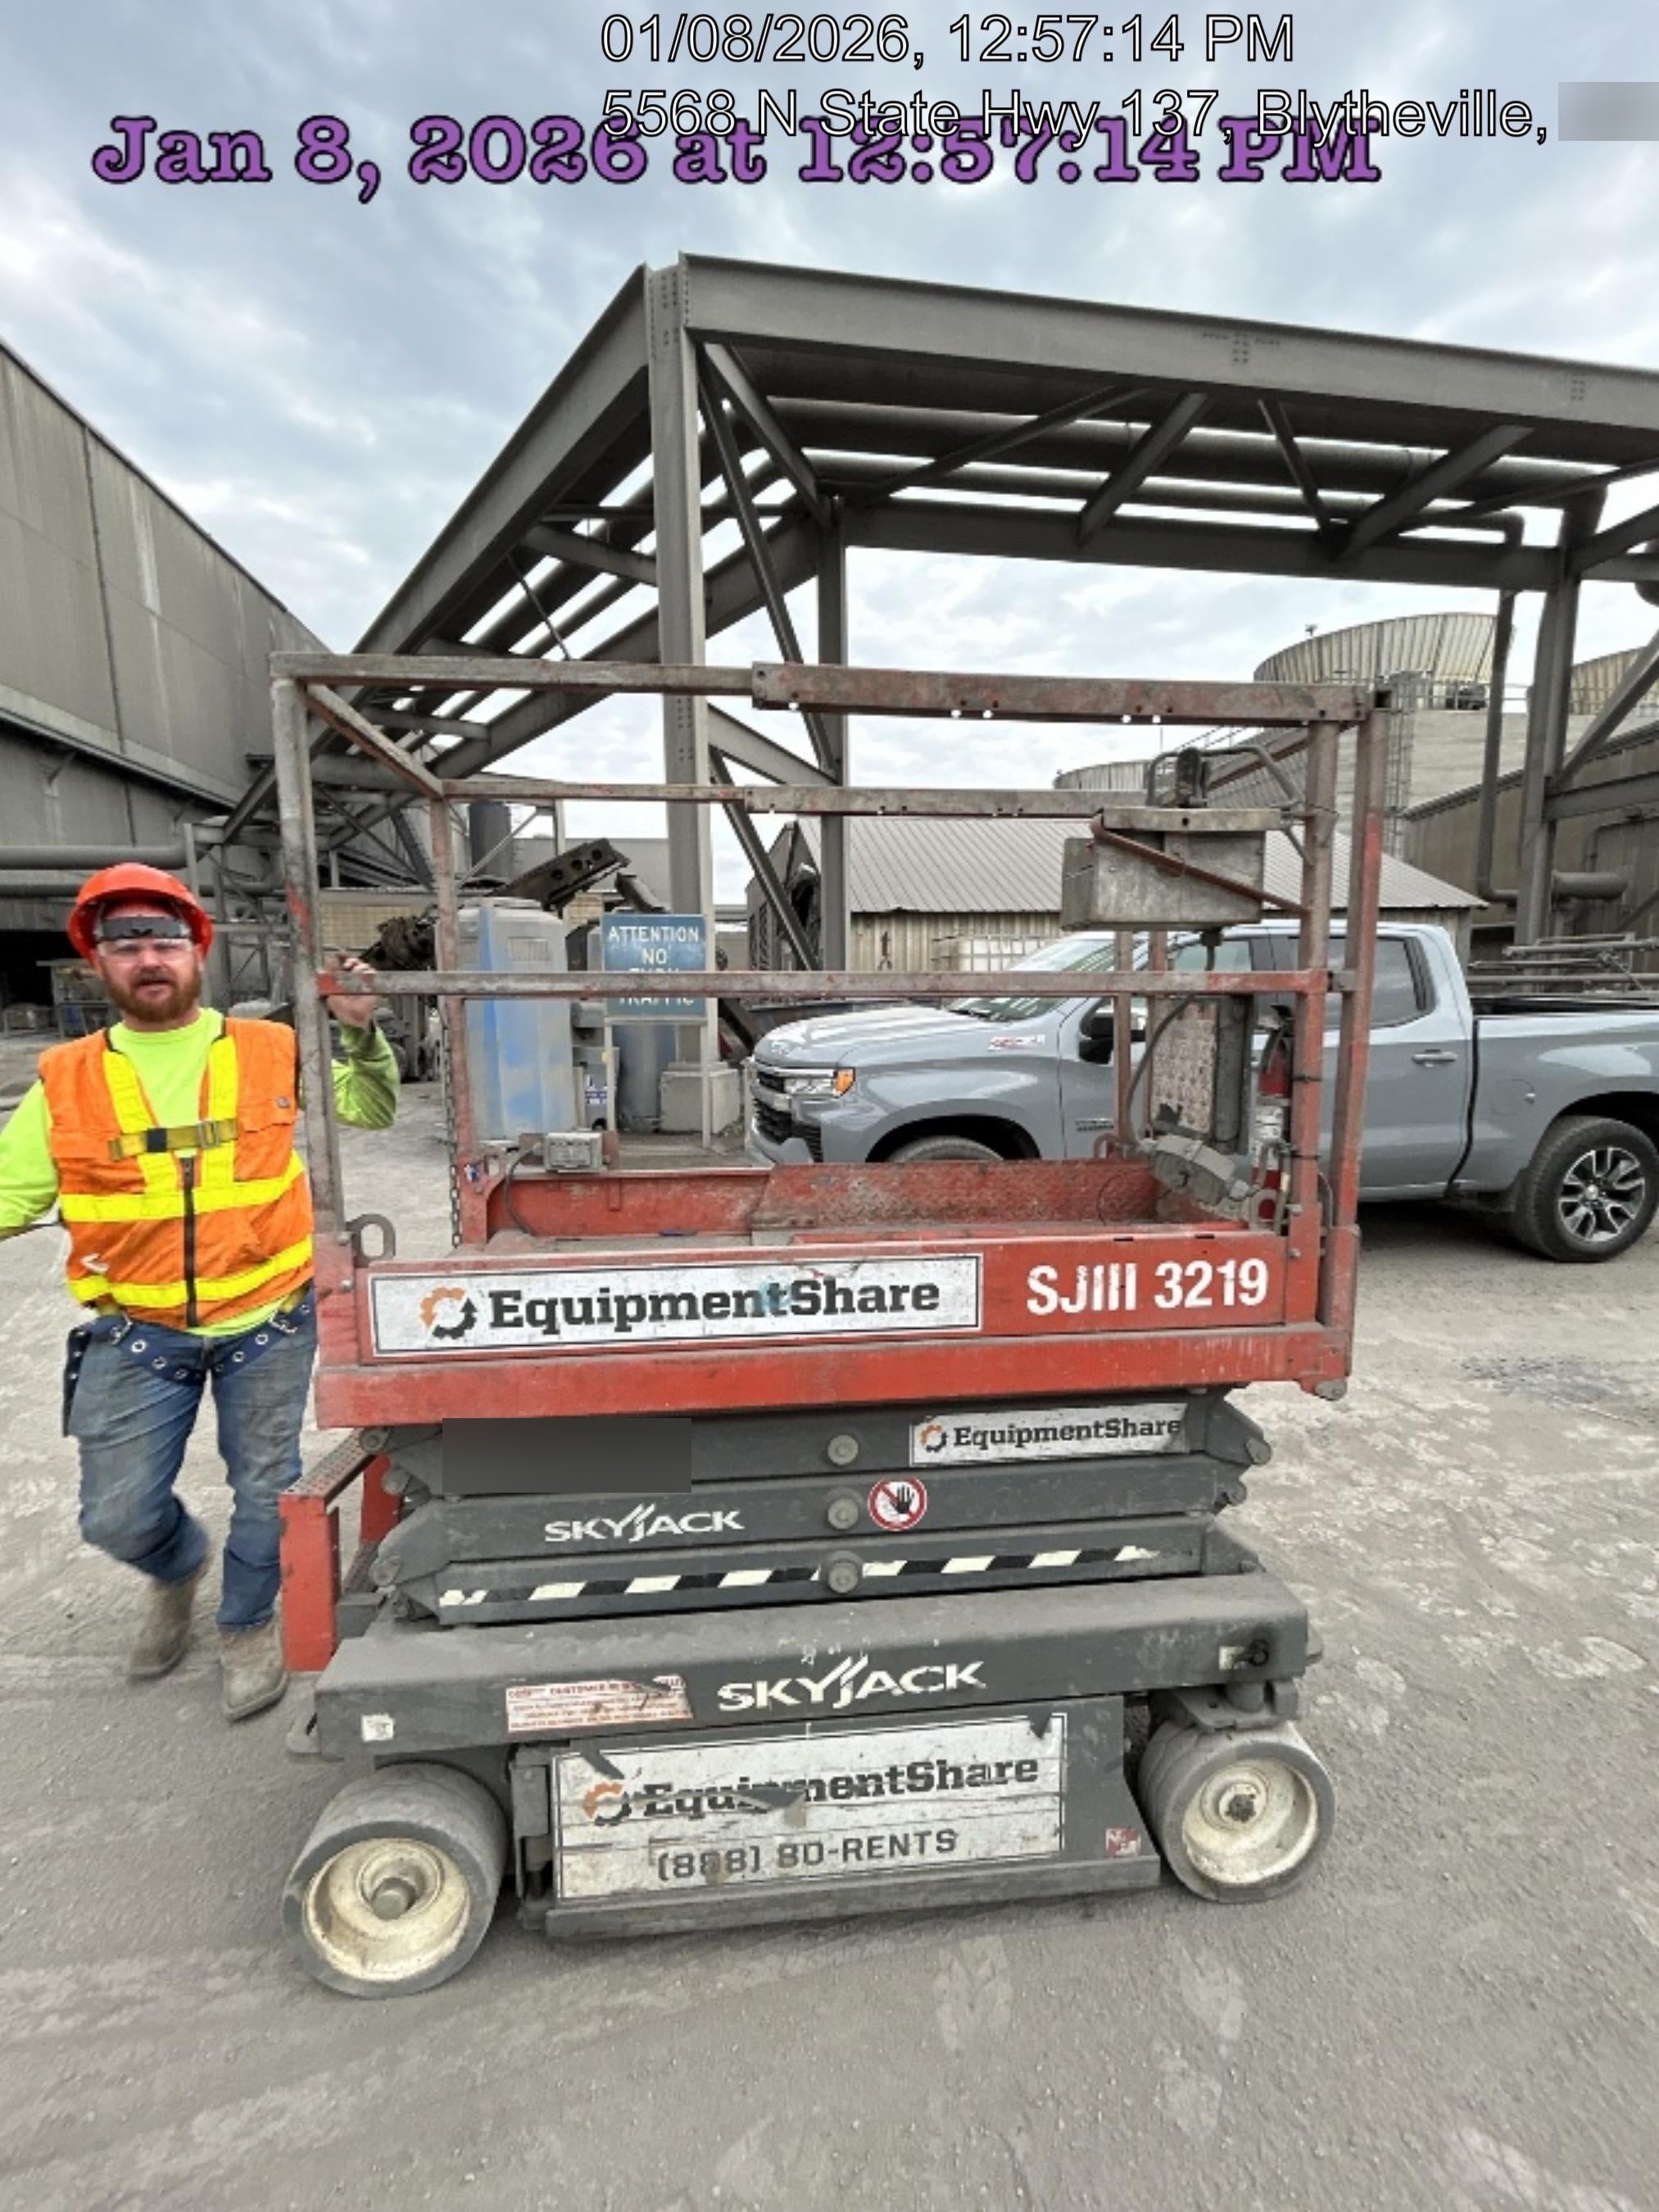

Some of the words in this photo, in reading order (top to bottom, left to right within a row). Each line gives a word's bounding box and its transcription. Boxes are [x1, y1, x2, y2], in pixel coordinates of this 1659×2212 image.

[608, 925, 700, 945] ATTENTION
[641, 947, 669, 966] NO
[488, 1276, 940, 1335] EquipmentShare
[1027, 1262, 1138, 1315] SJIII
[1154, 1258, 1269, 1309] 3219
[953, 1416, 1182, 1449] EquipmentShare
[545, 1503, 745, 1543] SKYJACK
[717, 1653, 987, 1711] SKYJACK
